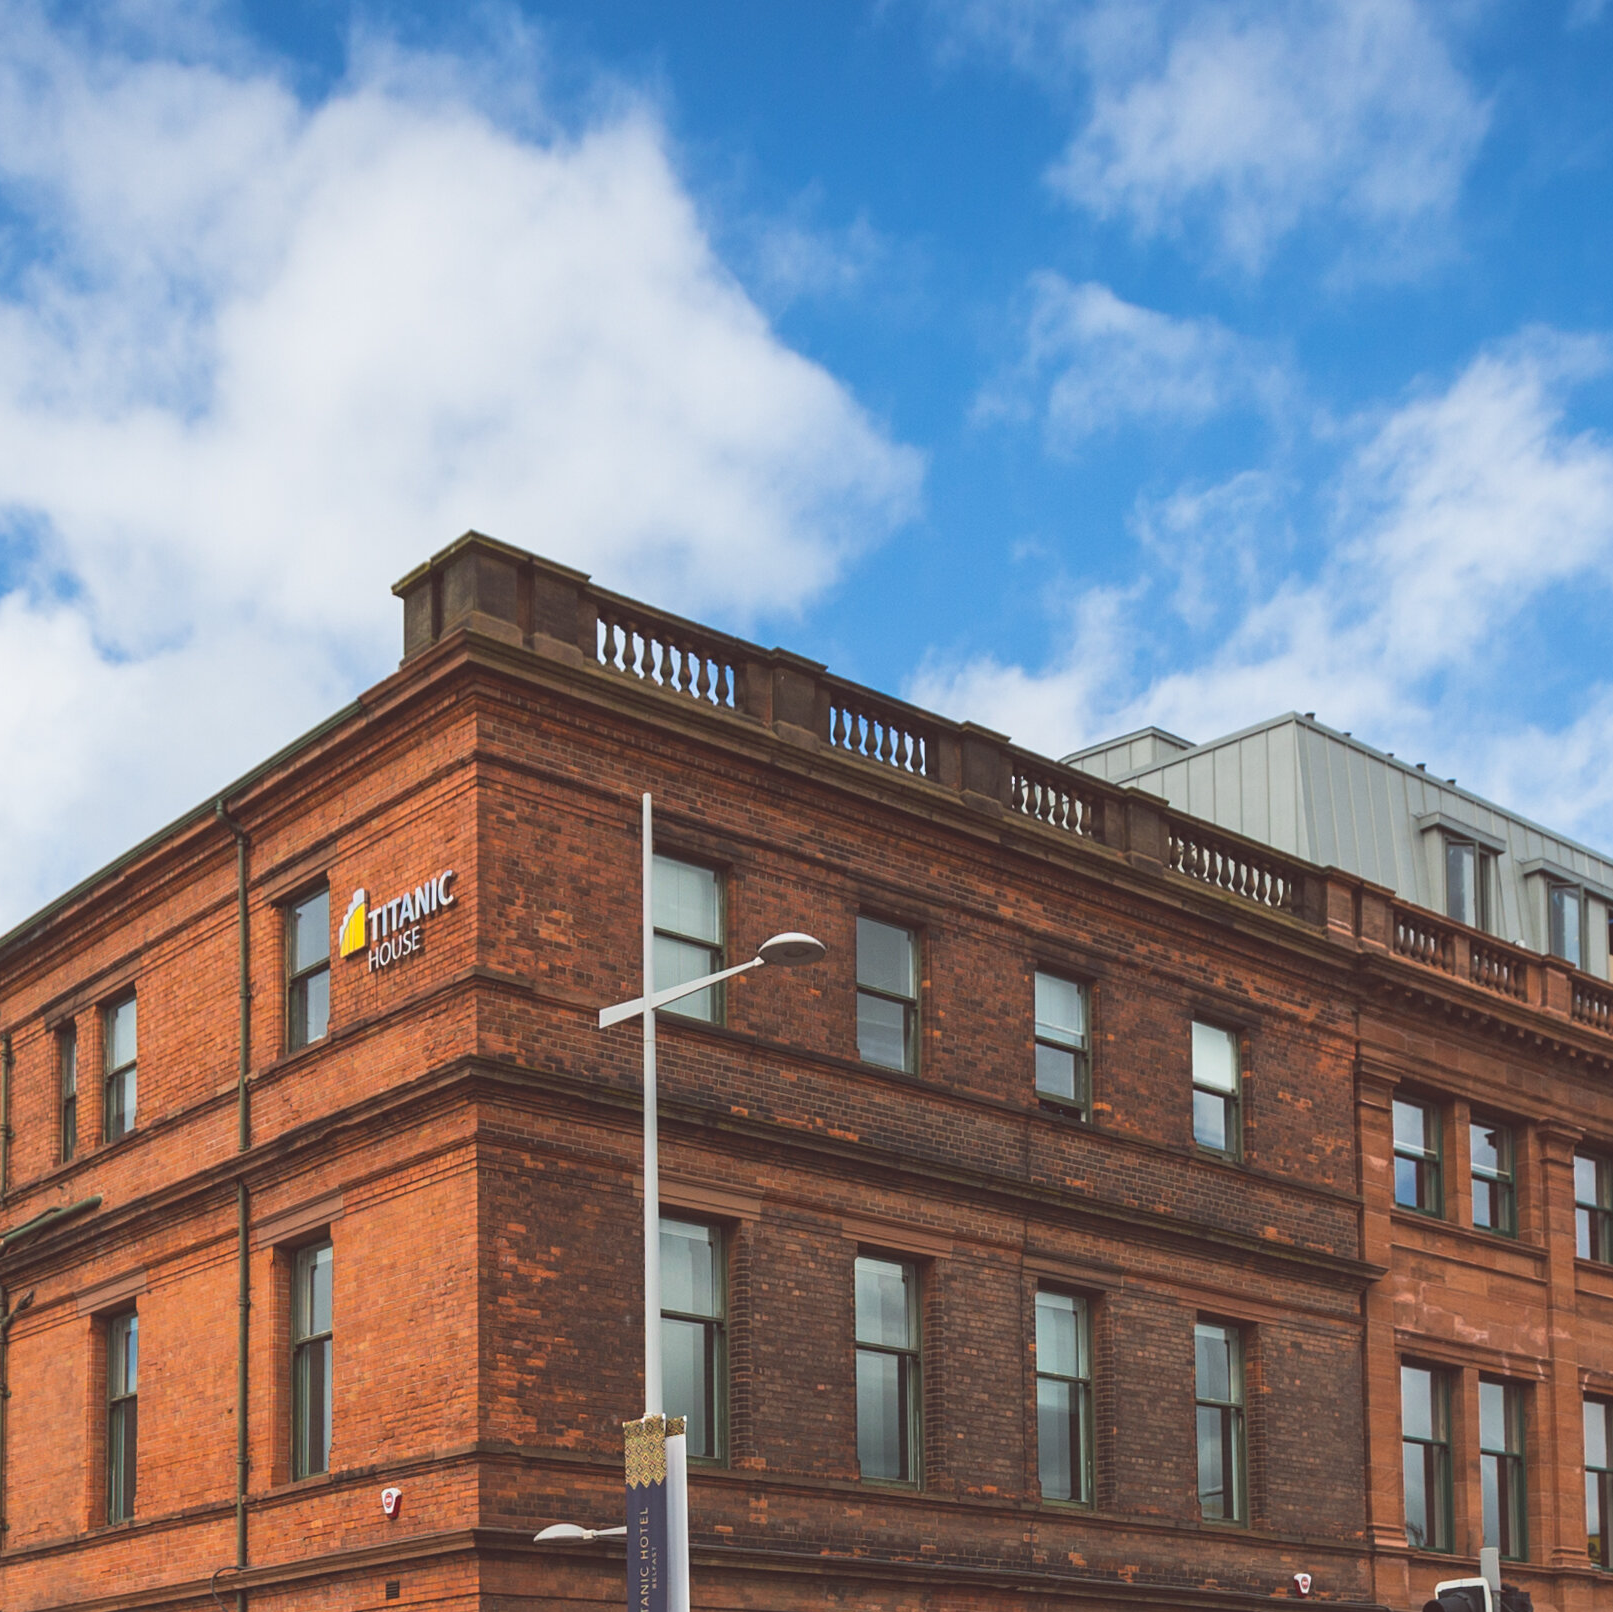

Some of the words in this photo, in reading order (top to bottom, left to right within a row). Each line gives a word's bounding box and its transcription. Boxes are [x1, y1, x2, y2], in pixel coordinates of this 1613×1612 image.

[368, 869, 454, 942] TITANIC
[368, 925, 421, 973] HOUSE
[640, 1507, 649, 1559] HOTEL
